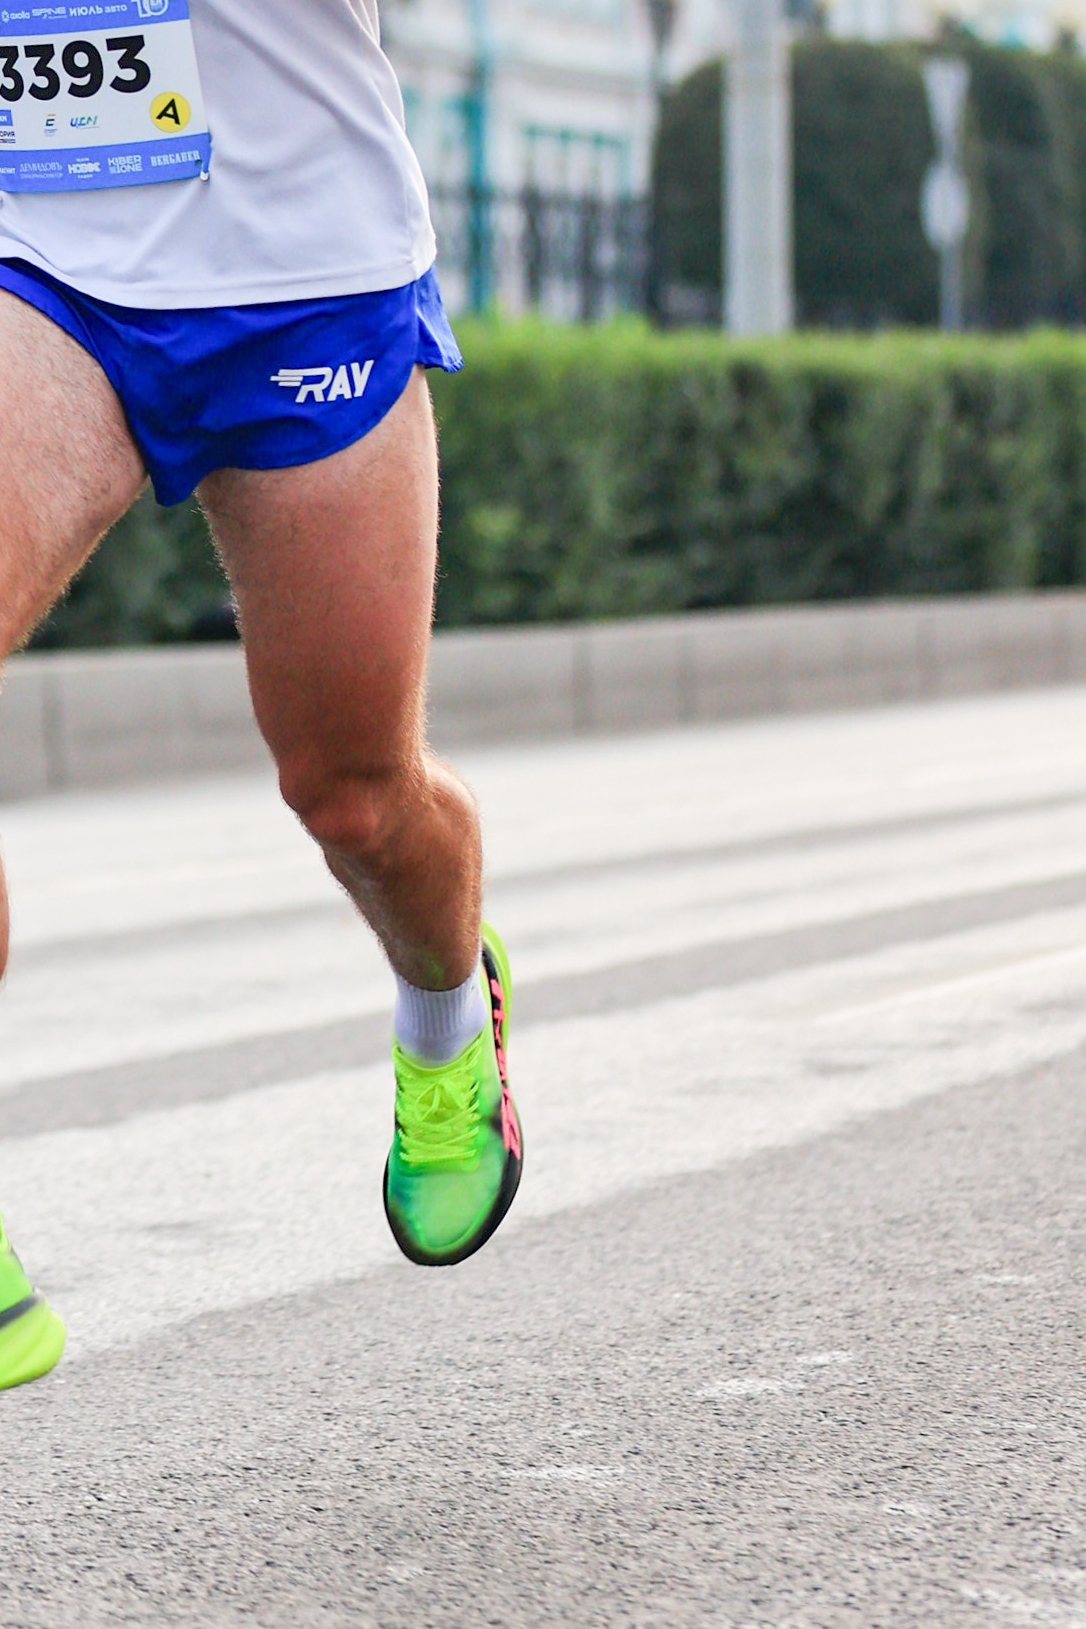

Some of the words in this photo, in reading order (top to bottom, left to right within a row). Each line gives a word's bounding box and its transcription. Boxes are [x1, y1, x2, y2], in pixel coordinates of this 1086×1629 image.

[69, 5, 104, 17] ИЮЛЬ
[156, 98, 181, 126] A
[270, 359, 375, 404] RAY
